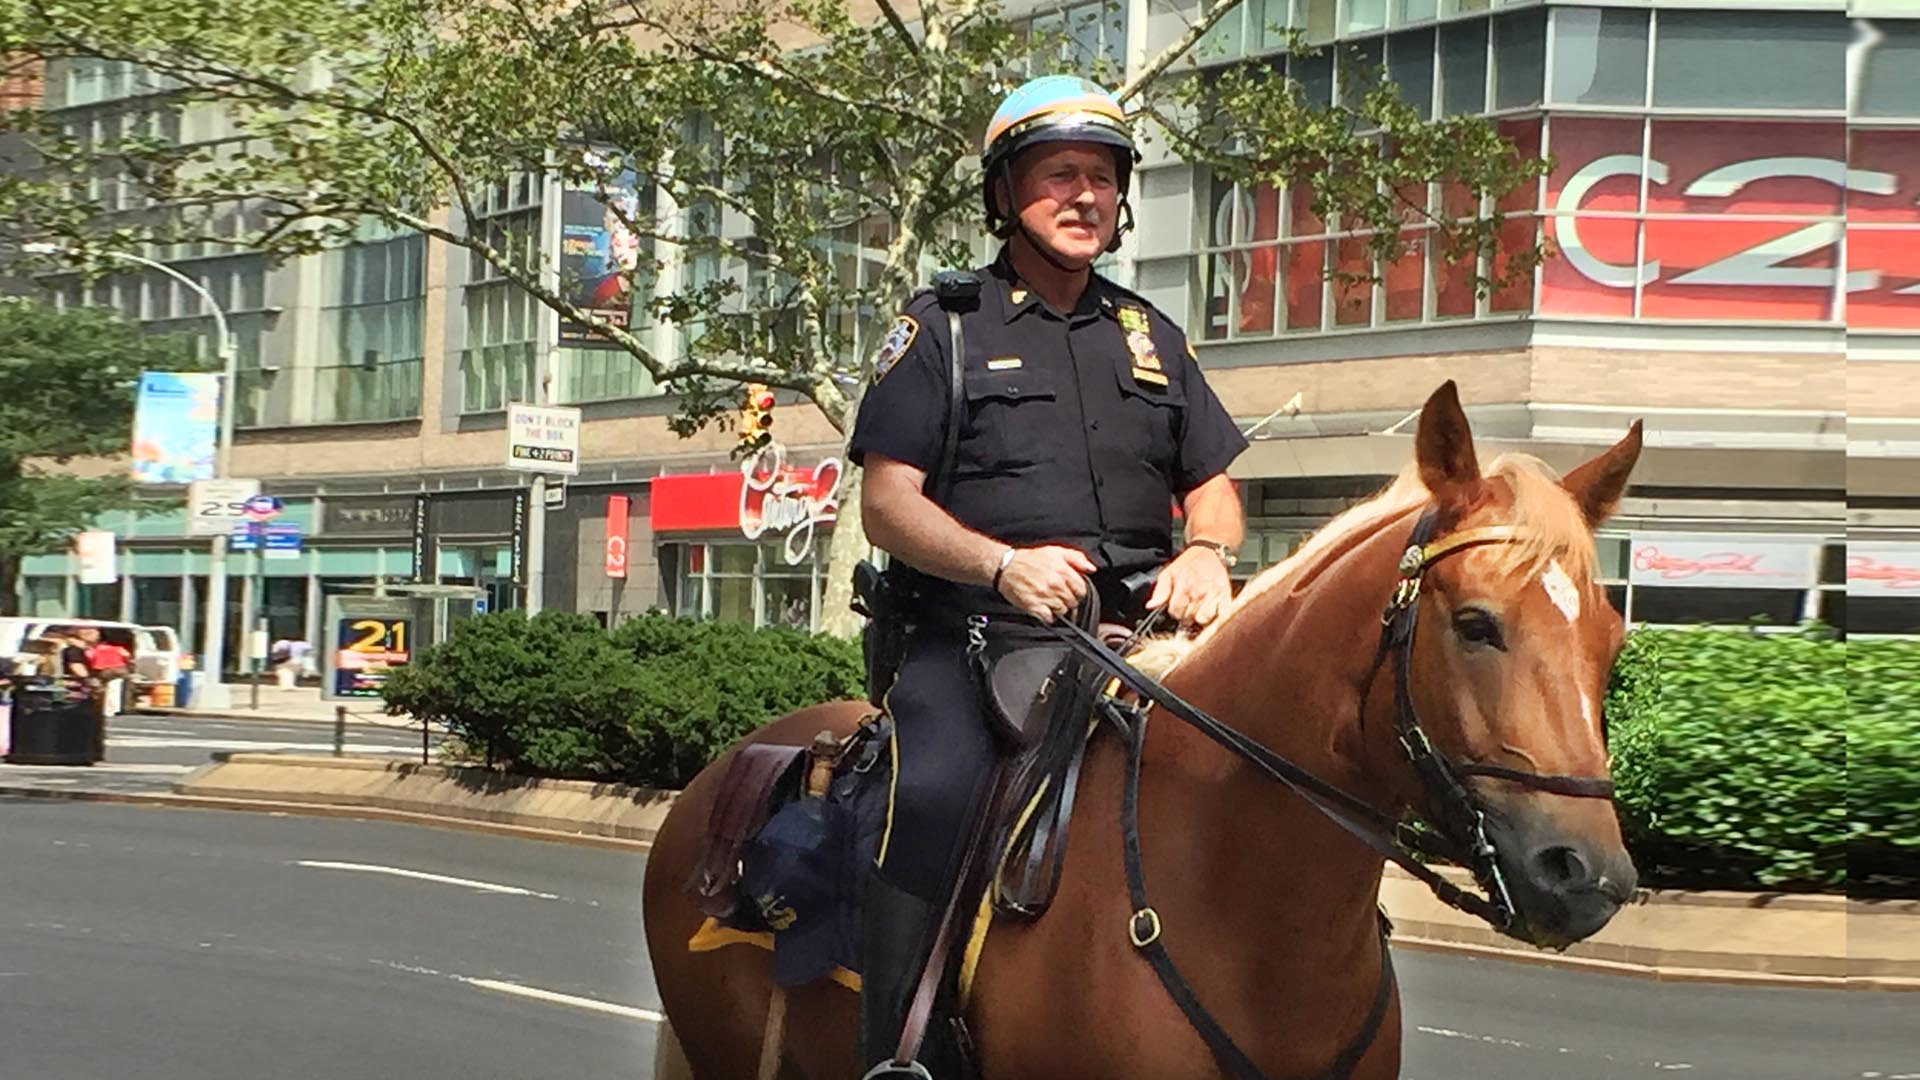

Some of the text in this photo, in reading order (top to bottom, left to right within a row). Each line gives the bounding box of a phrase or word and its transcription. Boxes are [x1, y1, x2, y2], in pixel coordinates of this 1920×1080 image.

[1555, 155, 1898, 293] C2
[545, 416, 574, 429] BLOCK
[606, 535, 626, 578] C21
